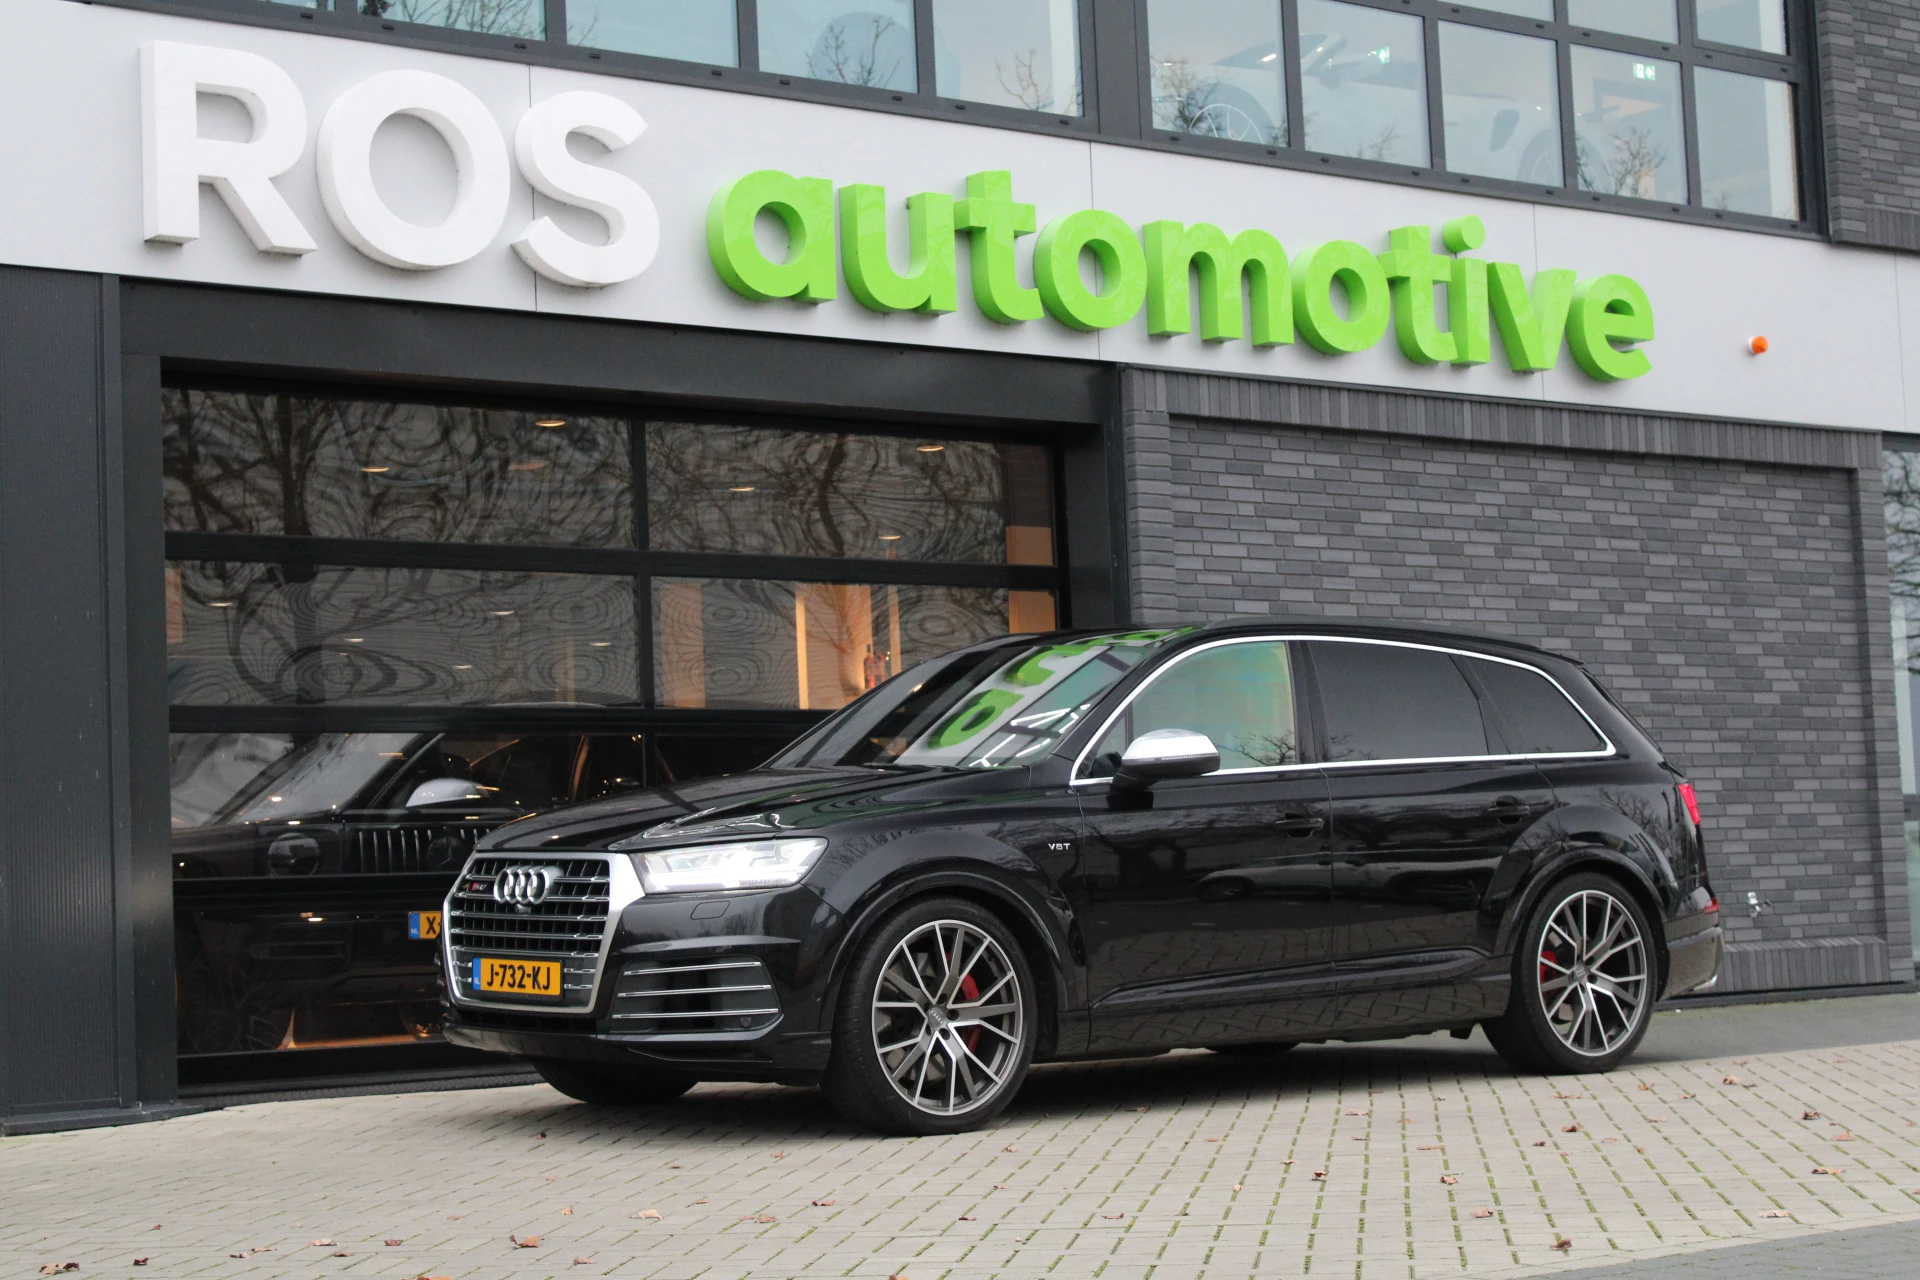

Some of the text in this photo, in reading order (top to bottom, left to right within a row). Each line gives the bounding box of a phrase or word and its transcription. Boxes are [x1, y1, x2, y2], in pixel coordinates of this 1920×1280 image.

[139, 40, 1654, 380] ROS automotive
[487, 963, 551, 991] J-732-KJ
